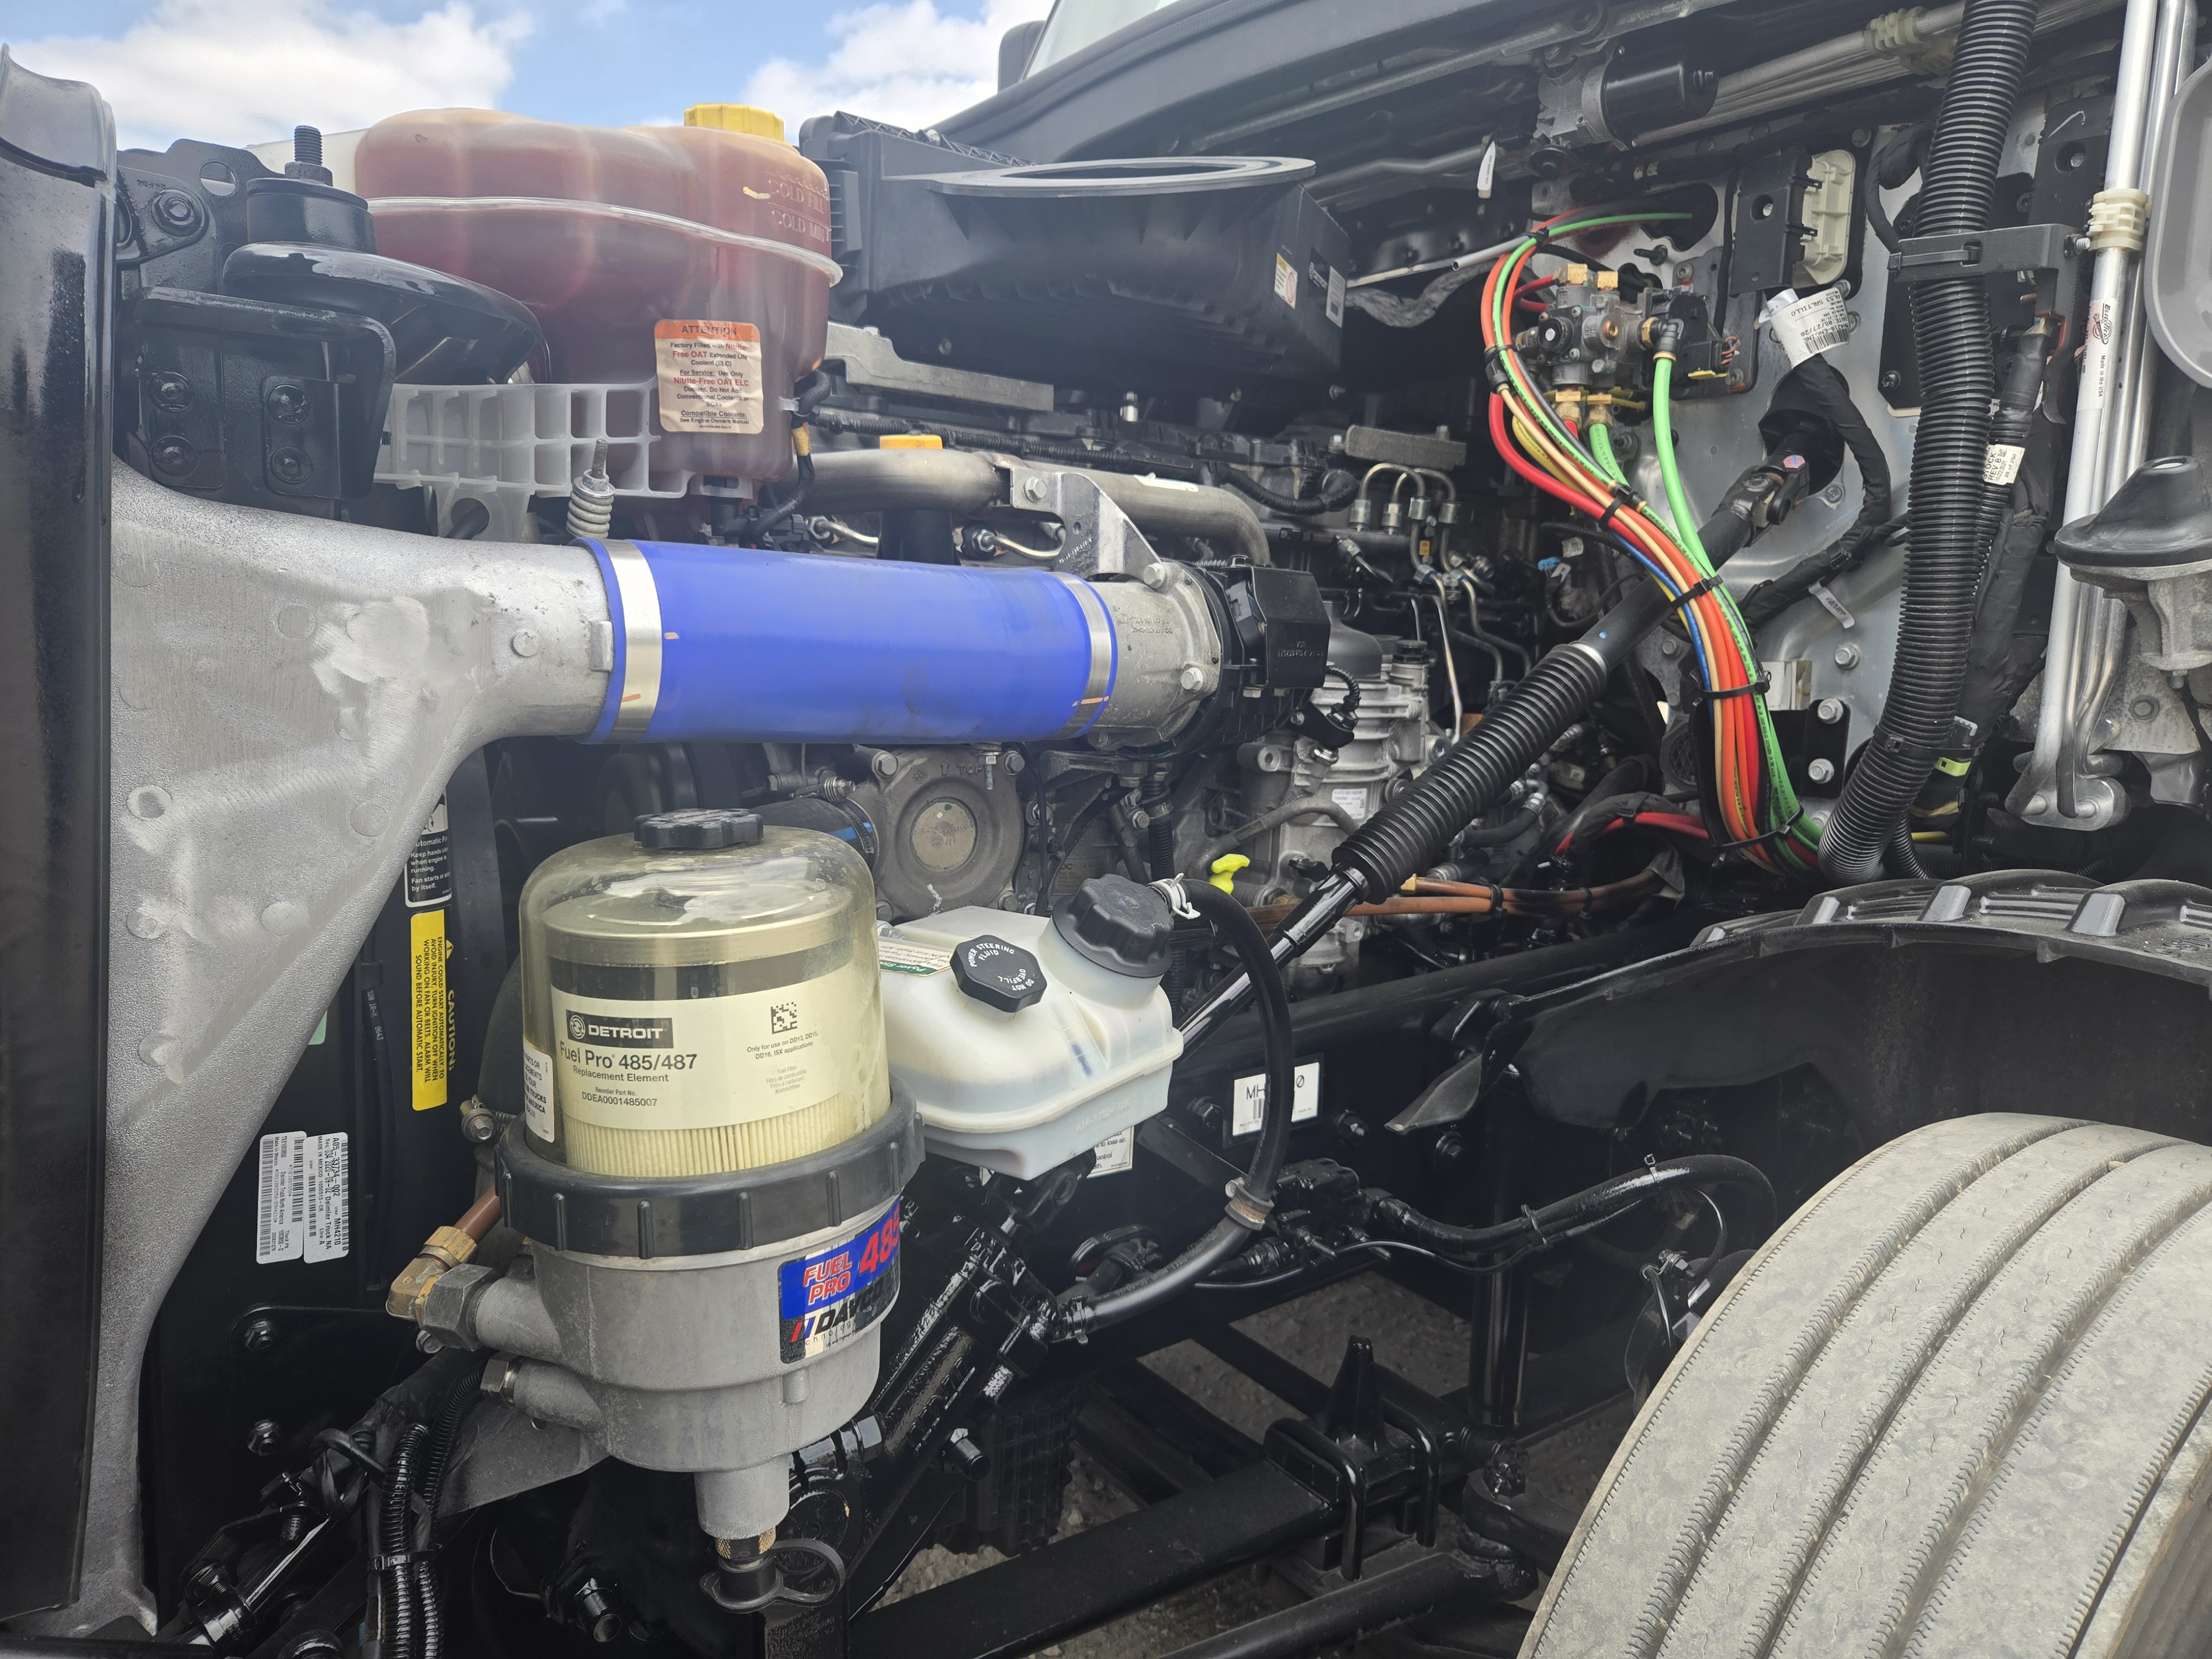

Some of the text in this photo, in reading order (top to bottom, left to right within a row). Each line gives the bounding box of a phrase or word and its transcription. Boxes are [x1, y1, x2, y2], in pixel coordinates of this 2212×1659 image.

[768, 179, 804, 203] COLD
[771, 210, 805, 233] COLD
[1791, 299, 1823, 316] SALTILLO
[682, 326, 736, 335] ATTENTION
[957, 763, 983, 774] TOP
[416, 838, 441, 847] utomatic
[967, 943, 1015, 967] POWER STEERING
[978, 950, 999, 961] FLUID
[424, 977, 430, 988] ON
[997, 968, 1026, 984] OVERFILL
[424, 1007, 430, 1017] OR
[588, 1024, 664, 1039] DETROIT
[790, 1035, 804, 1044] DD13,
[805, 1031, 818, 1040] DD15,
[784, 1041, 813, 1053] applications
[560, 1040, 581, 1063] Fuel
[619, 1054, 697, 1070] 485/487
[534, 1061, 540, 1070] OR
[439, 1069, 444, 1079] TO
[573, 1065, 669, 1082] Replacement Element
[528, 1076, 536, 1088] YOUR
[530, 1088, 546, 1103] TRUCKS
[582, 1092, 658, 1106] DDEA0001485007
[529, 1096, 545, 1114] AMERICA
[1097, 1151, 1112, 1160] ontrol
[326, 1241, 331, 1250] NA
[802, 1251, 852, 1287] FUEL
[808, 1271, 851, 1306] PRO
